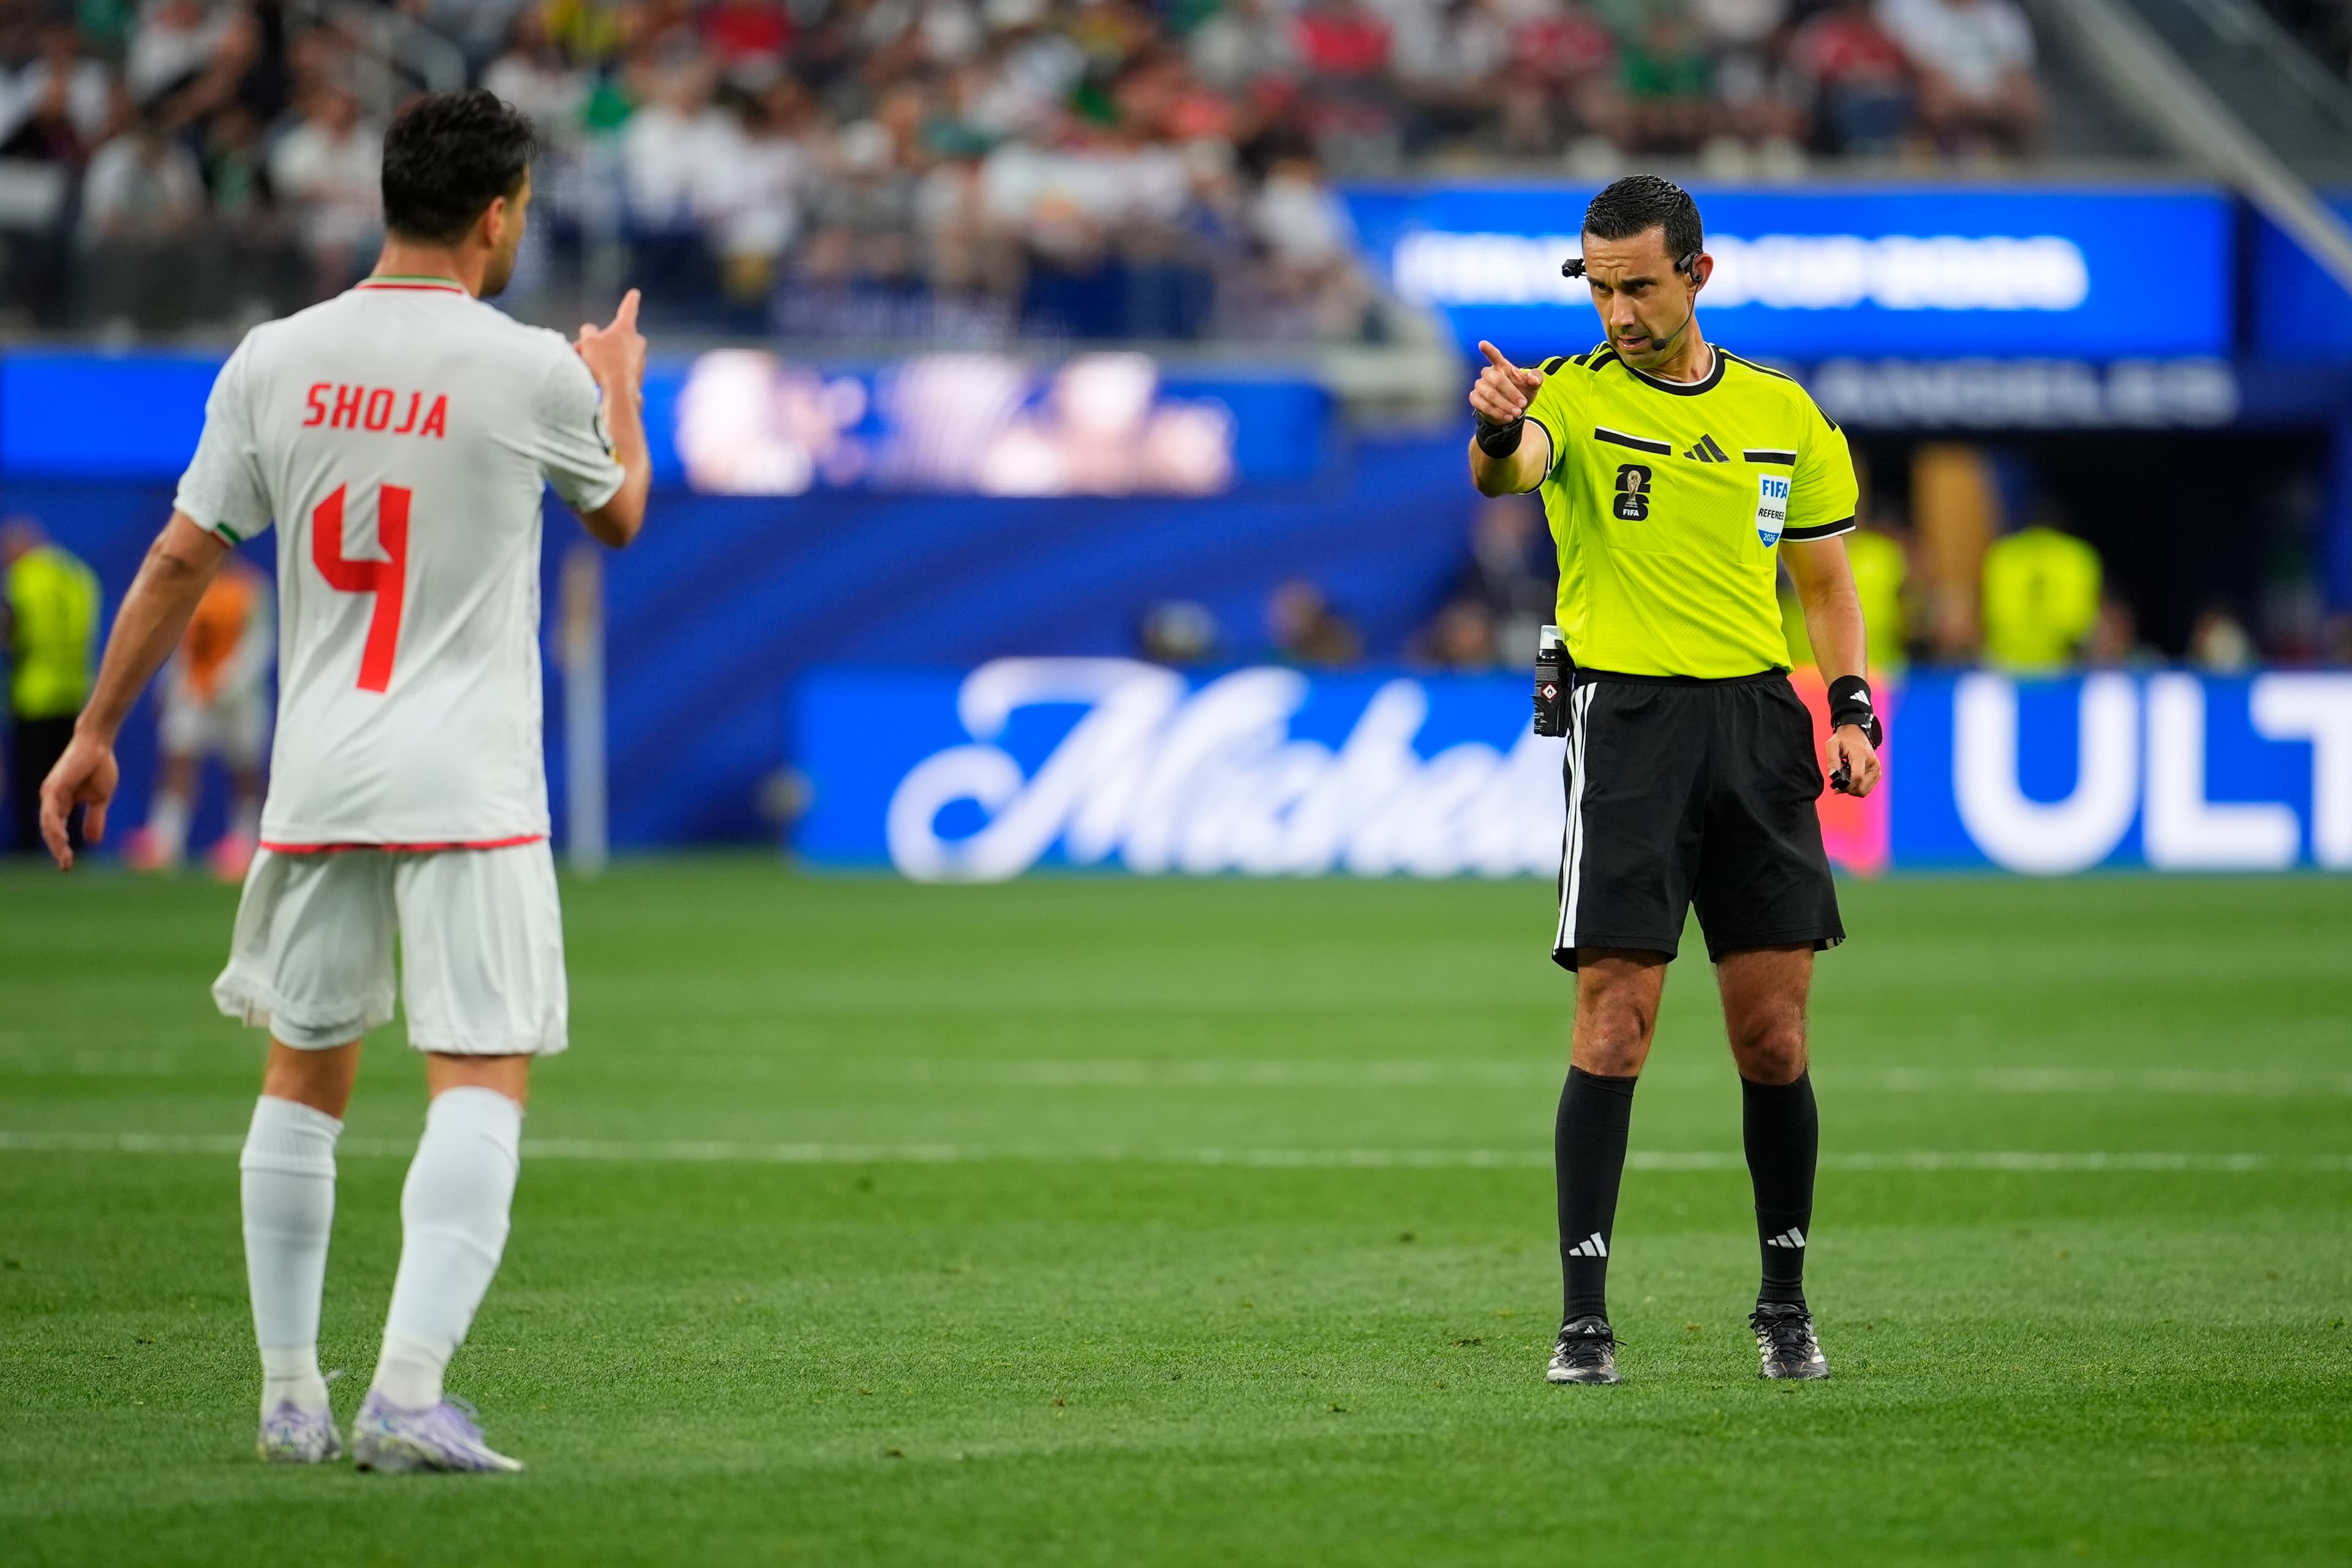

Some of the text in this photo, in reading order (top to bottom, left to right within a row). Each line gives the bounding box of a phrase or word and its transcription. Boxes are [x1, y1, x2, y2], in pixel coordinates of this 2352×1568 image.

[303, 383, 448, 440] SHOJA
[1762, 479, 1788, 499] FIFA
[1623, 508, 1640, 517] FIFA
[1758, 508, 1785, 521] REFEREE
[1763, 532, 1776, 543] 2026
[313, 481, 412, 694] 4
[1953, 672, 2352, 876] ULT
